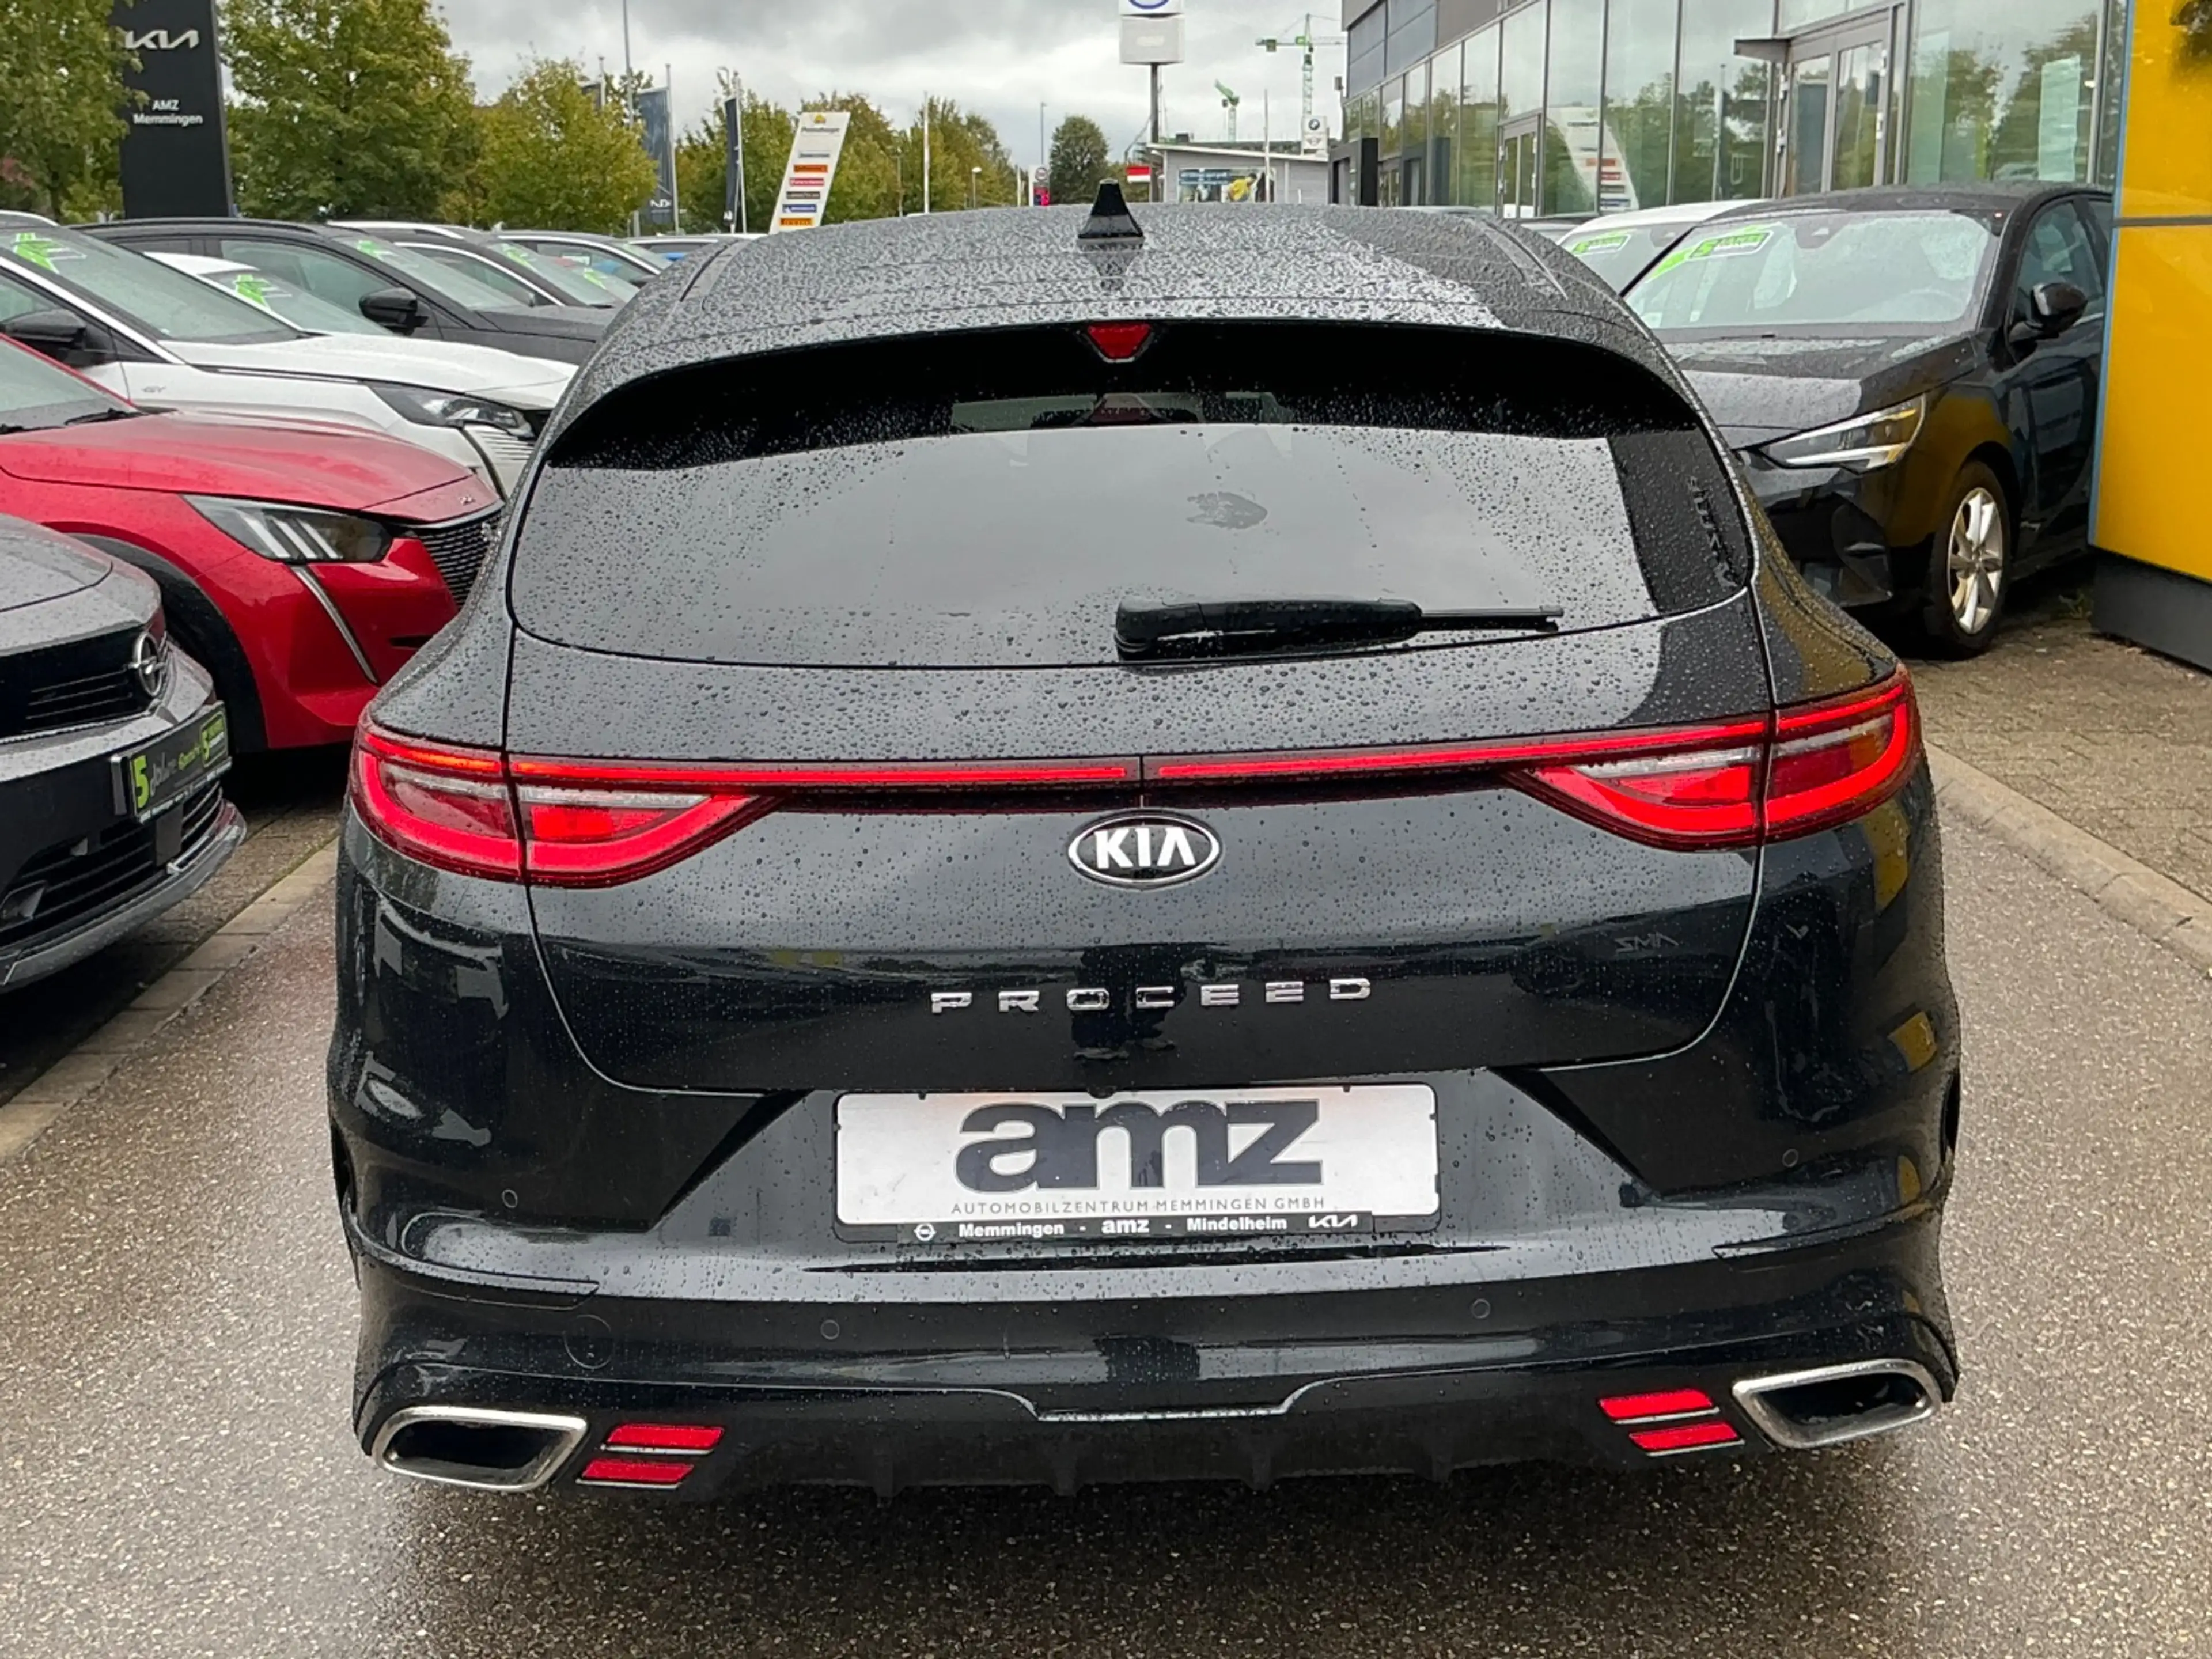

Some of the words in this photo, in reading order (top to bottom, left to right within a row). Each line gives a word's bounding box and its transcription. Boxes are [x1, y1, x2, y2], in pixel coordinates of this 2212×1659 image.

[125, 29, 199, 49] KIA
[152, 99, 179, 111] AMZ
[133, 113, 203, 127] Memmingen
[133, 754, 149, 808] 5
[1094, 827, 1196, 869] KIA
[931, 978, 1371, 1013] PROCEED
[953, 1099, 1323, 1194] amz
[952, 1200, 1148, 1214] AUTOMOBILZENTRUM
[1156, 1198, 1267, 1211] MEMMINGEN
[1274, 1196, 1324, 1209] GMBH
[959, 1222, 1065, 1238] Memmingen
[1101, 1219, 1150, 1233] amz
[1187, 1217, 1287, 1231] Mindelheim
[1308, 1214, 1358, 1228] KIA
